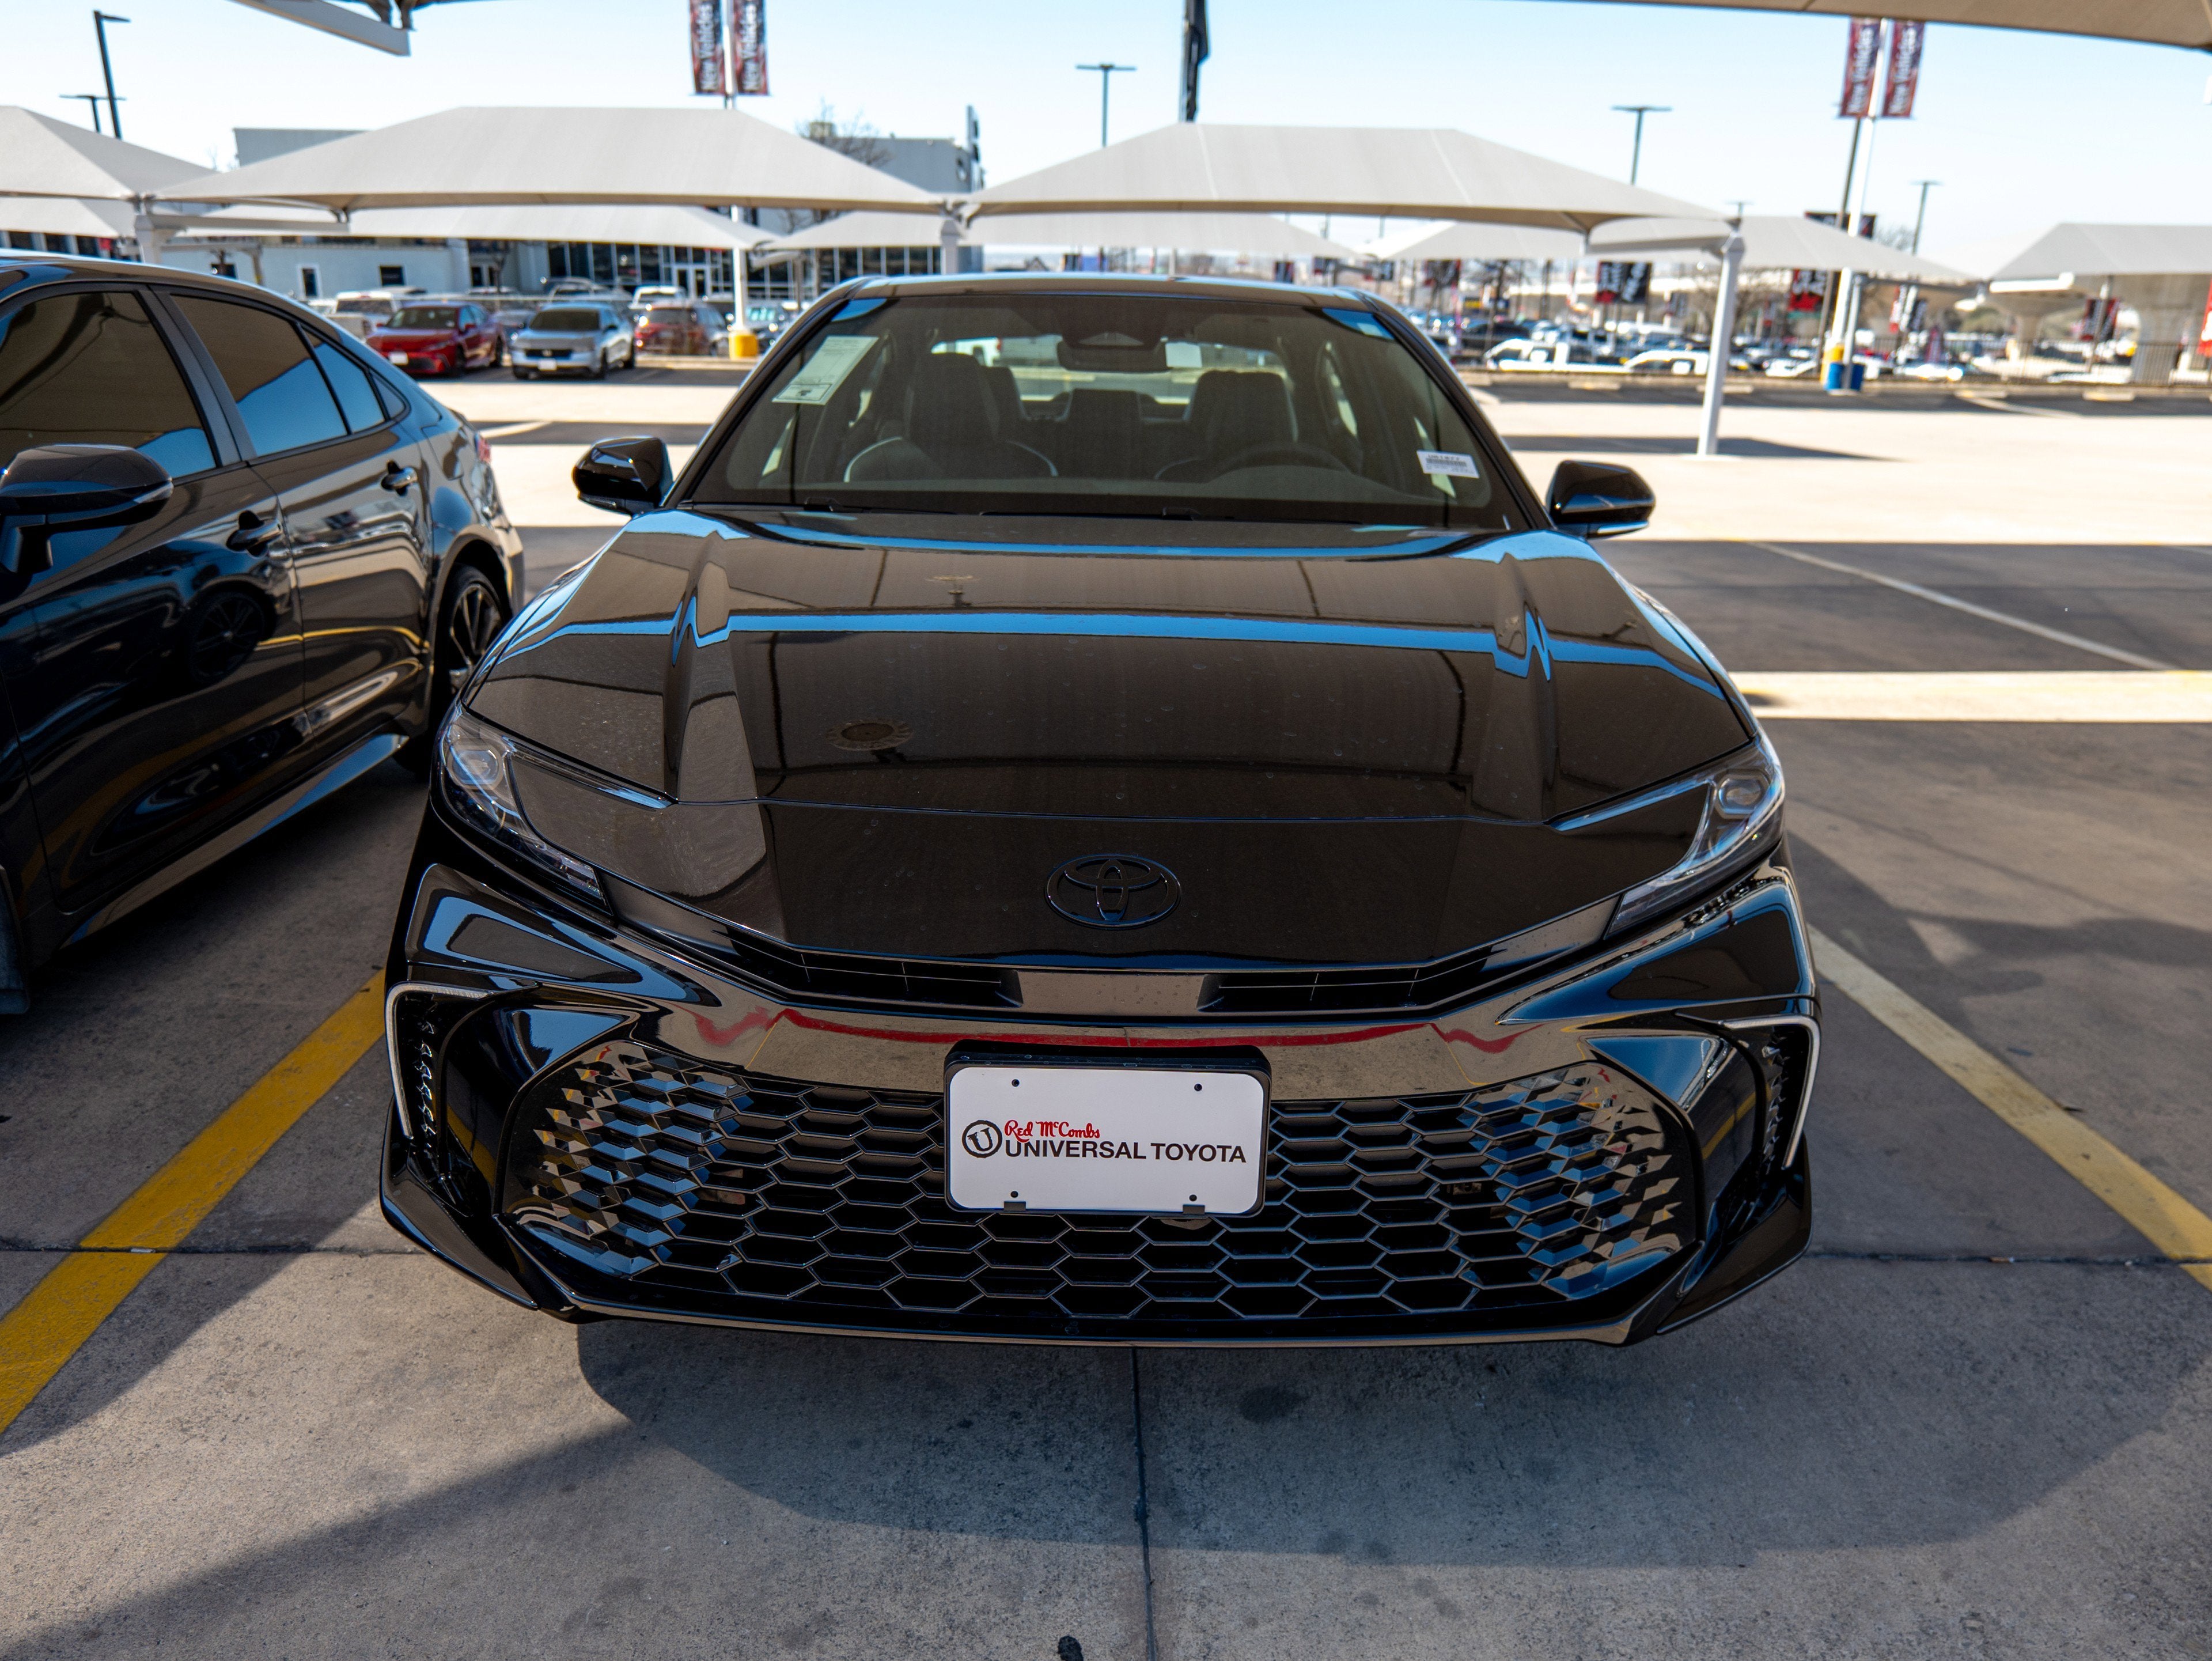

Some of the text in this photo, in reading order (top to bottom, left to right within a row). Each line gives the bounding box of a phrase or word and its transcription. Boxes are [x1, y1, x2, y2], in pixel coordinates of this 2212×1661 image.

[696, 3, 718, 90] New Vehicles
[739, 3, 761, 90] New Vehicles
[1004, 1119, 1100, 1143] Red McCombs
[1005, 1140, 1247, 1163] UNIVERSAL TOYOTA
